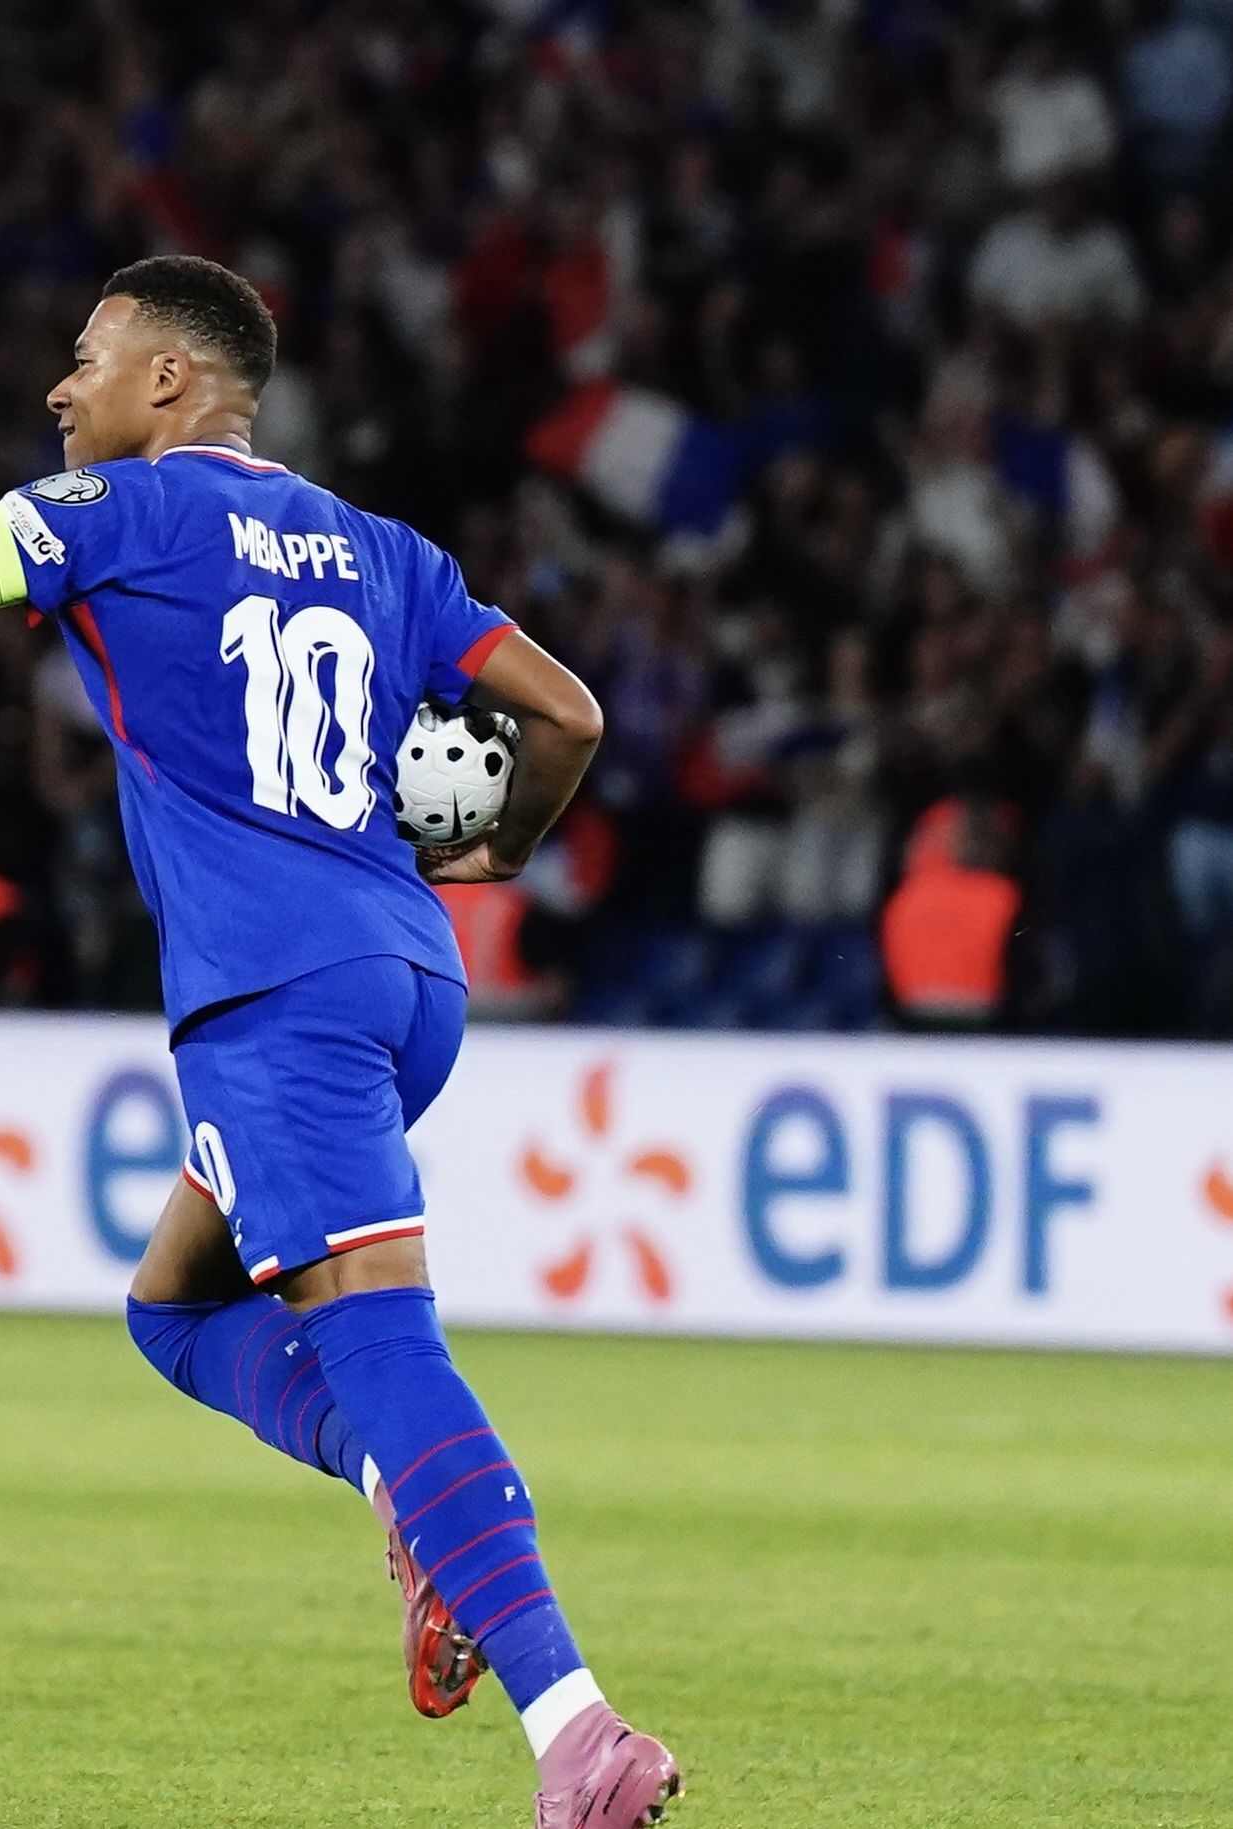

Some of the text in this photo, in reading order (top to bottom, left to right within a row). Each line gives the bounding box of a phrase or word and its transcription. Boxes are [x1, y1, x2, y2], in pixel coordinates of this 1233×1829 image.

[227, 513, 360, 581] MBAPPE
[220, 594, 376, 833] 10
[195, 1121, 236, 1216] 0
